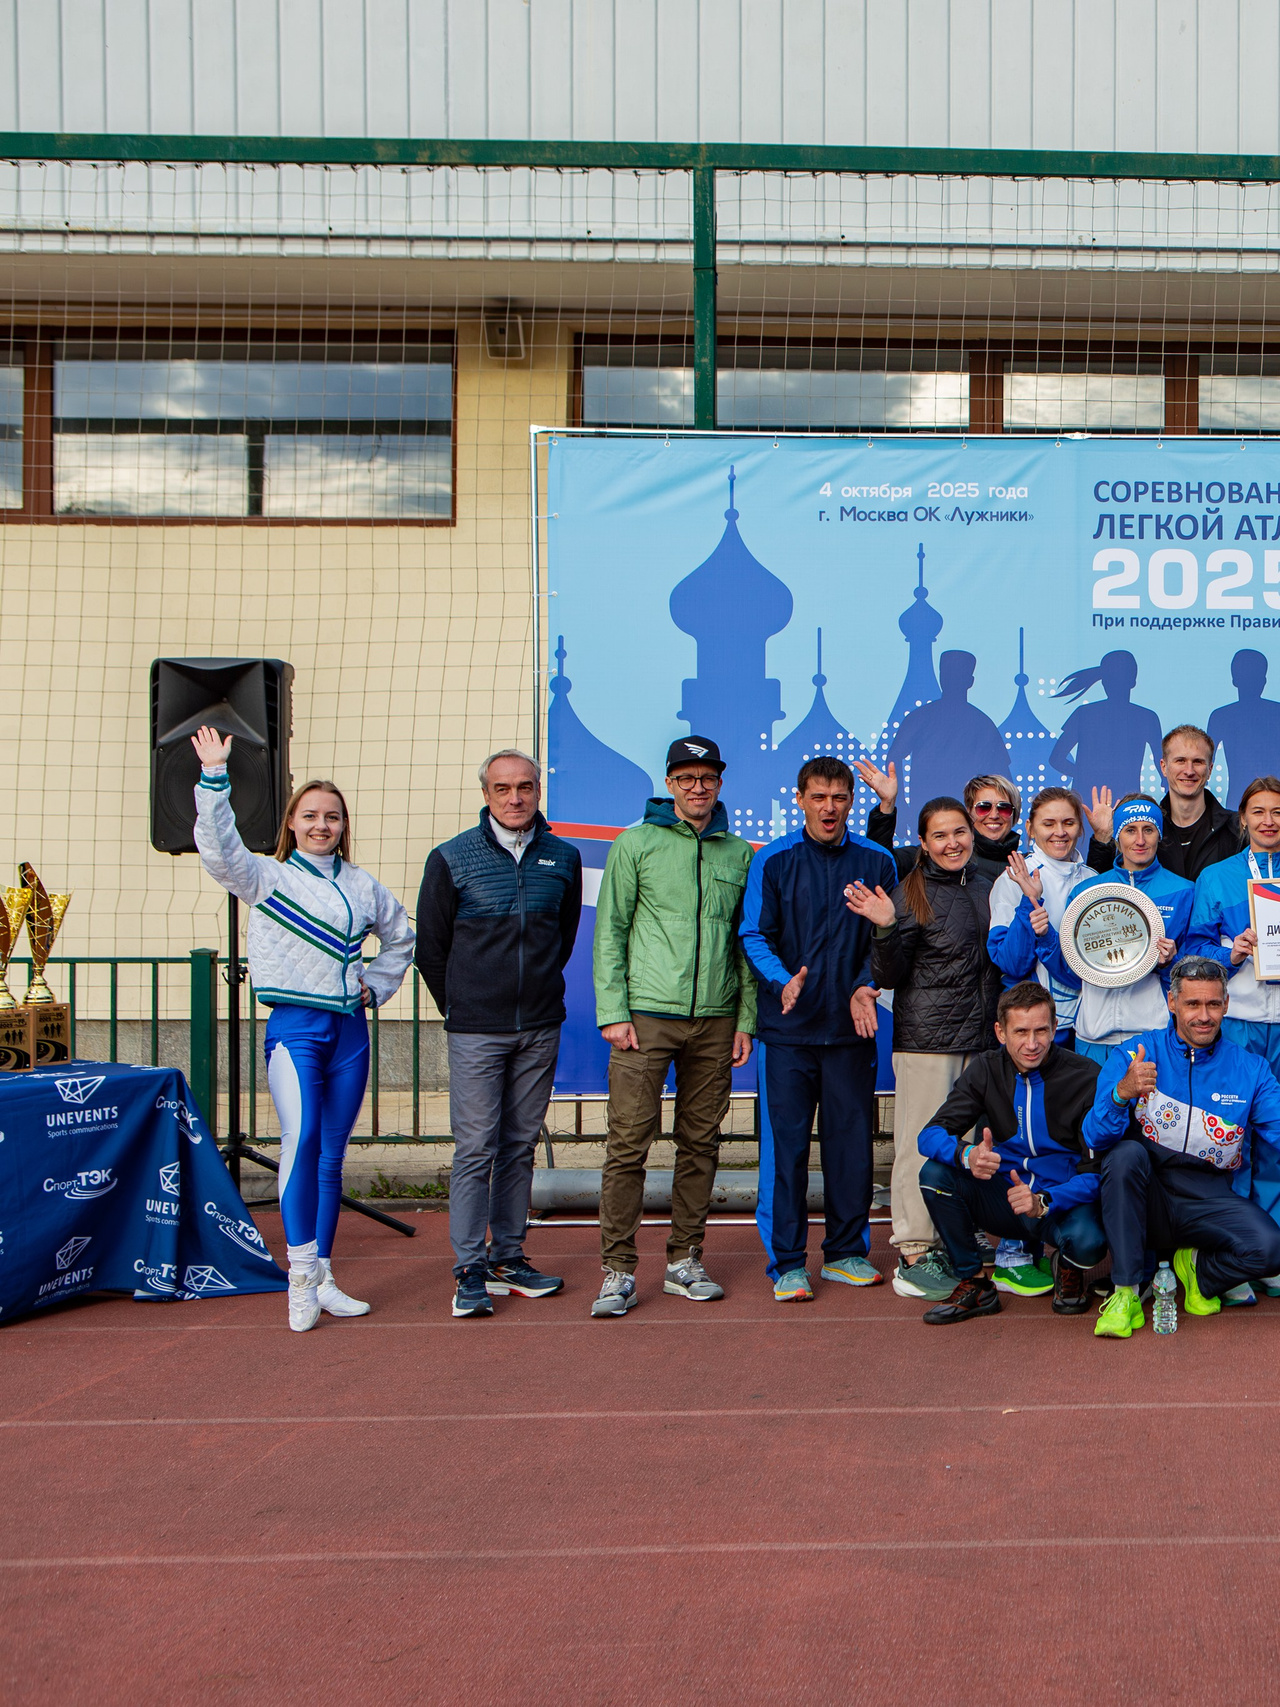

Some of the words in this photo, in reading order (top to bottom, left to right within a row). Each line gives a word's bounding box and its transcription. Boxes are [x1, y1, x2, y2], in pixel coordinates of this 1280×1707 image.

[819, 482, 832, 498] 4
[841, 482, 912, 501] октября
[927, 482, 979, 498] 2025
[988, 484, 1028, 500] года
[818, 510, 830, 522] г.
[839, 506, 908, 522] Москва
[913, 506, 941, 522] ОК
[944, 506, 1034, 526] «Лужники»
[1092, 507, 1223, 540] ЛЕГКОЙ
[1092, 613, 1125, 630] При
[1130, 615, 1226, 630] поддержке
[1082, 904, 1136, 929] УЧАСТНИК
[1084, 937, 1113, 951] 2025
[46, 1106, 119, 1127] UNEVENTS
[47, 1129, 68, 1139] Sports
[68, 1121, 119, 1136] communications
[39, 1266, 95, 1296] UNEVENTS
